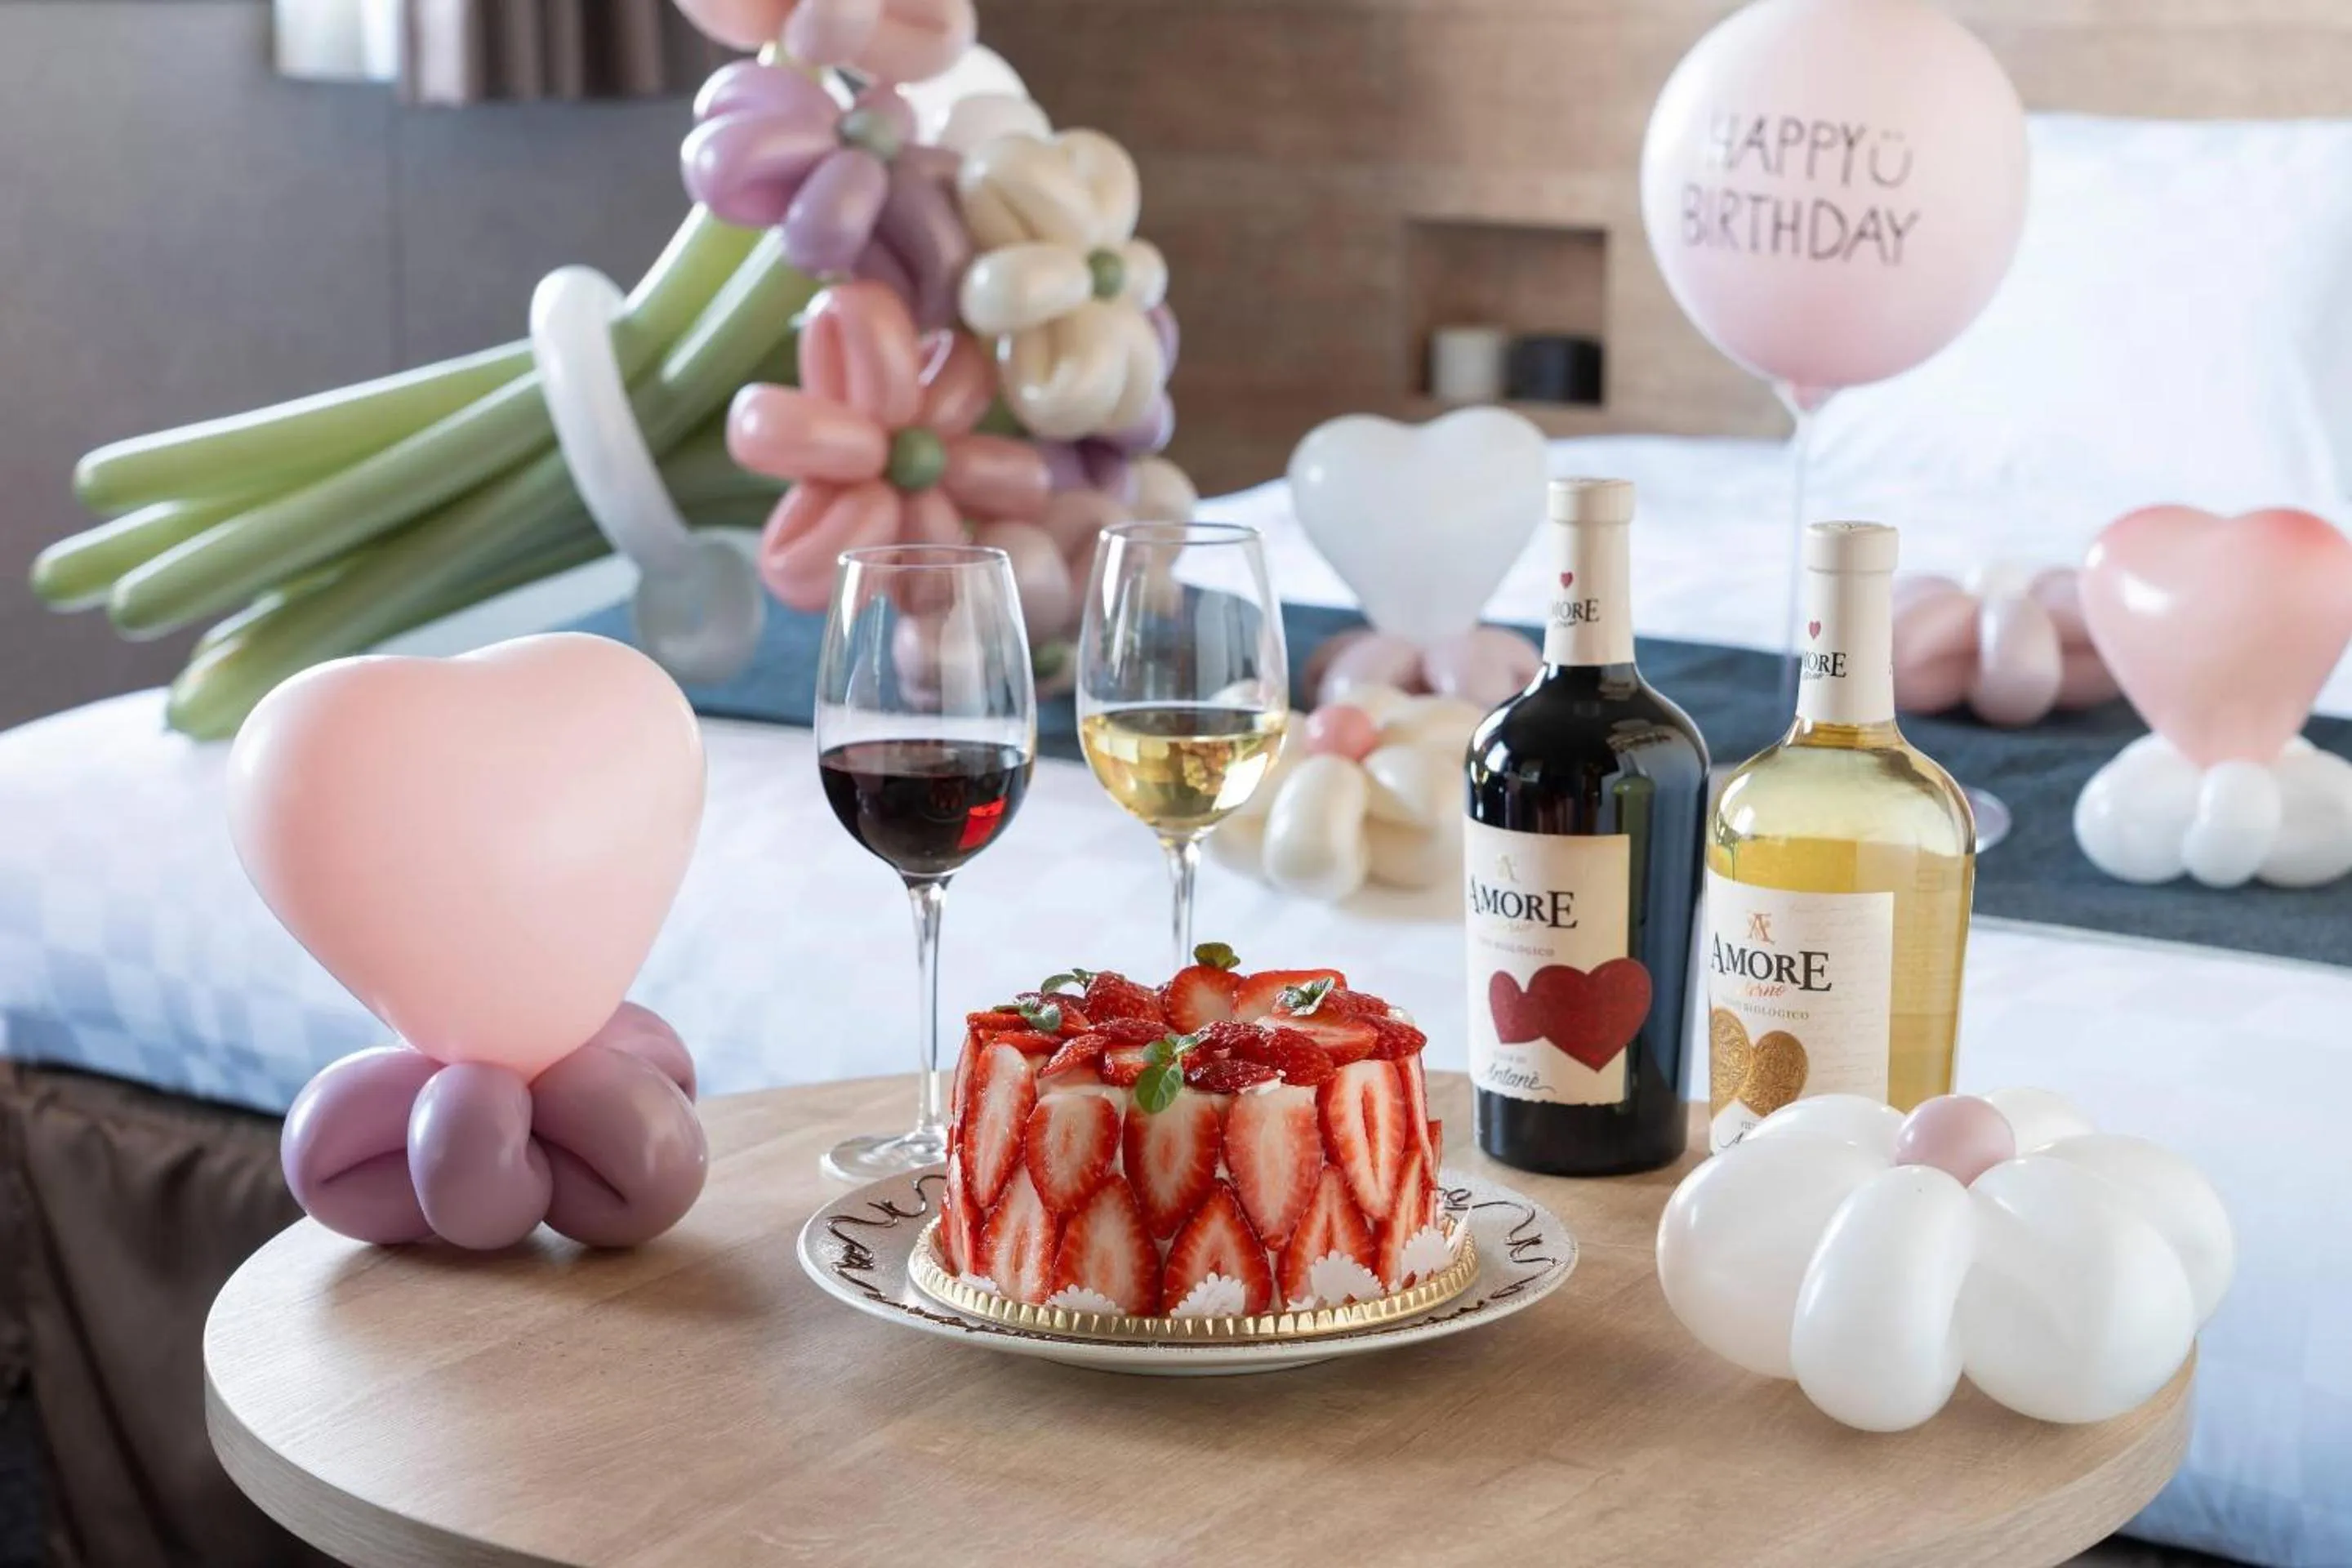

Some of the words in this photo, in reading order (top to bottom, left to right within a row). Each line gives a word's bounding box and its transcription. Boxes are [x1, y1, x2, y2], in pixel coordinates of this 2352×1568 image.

[1708, 114, 1868, 188] HAPPY
[1682, 183, 1920, 267] BIRTHDAY
[1711, 932, 1833, 991] AMORE
